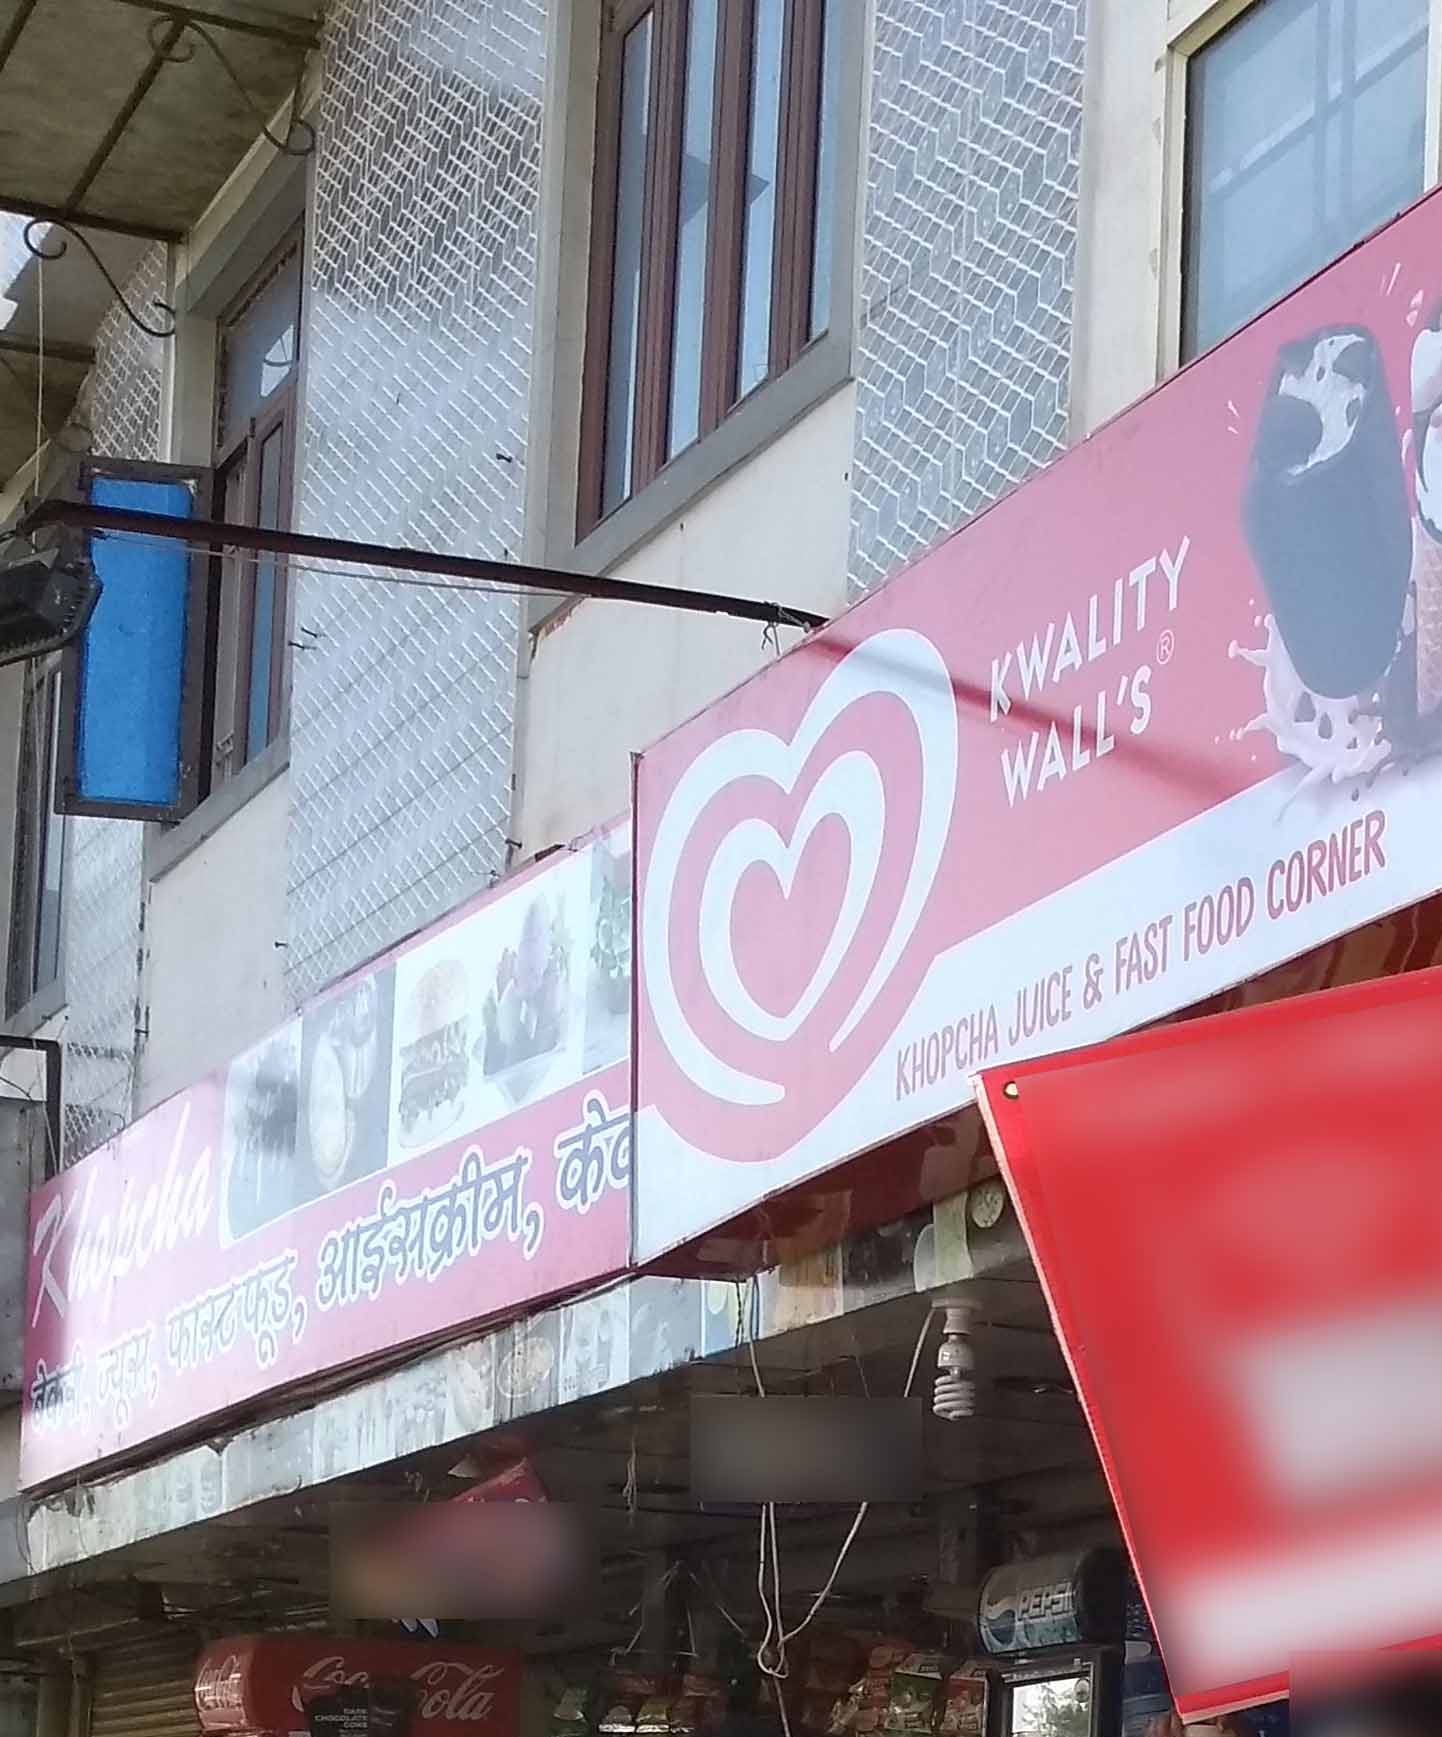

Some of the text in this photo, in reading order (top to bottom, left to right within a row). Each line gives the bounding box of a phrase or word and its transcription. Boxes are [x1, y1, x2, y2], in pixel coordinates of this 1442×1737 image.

[989, 536, 1193, 721] KWALITY
[999, 669, 1152, 809] WALL'S
[895, 808, 1388, 1101] KHOPCHA JUICE & FAST FOOD CORNER
